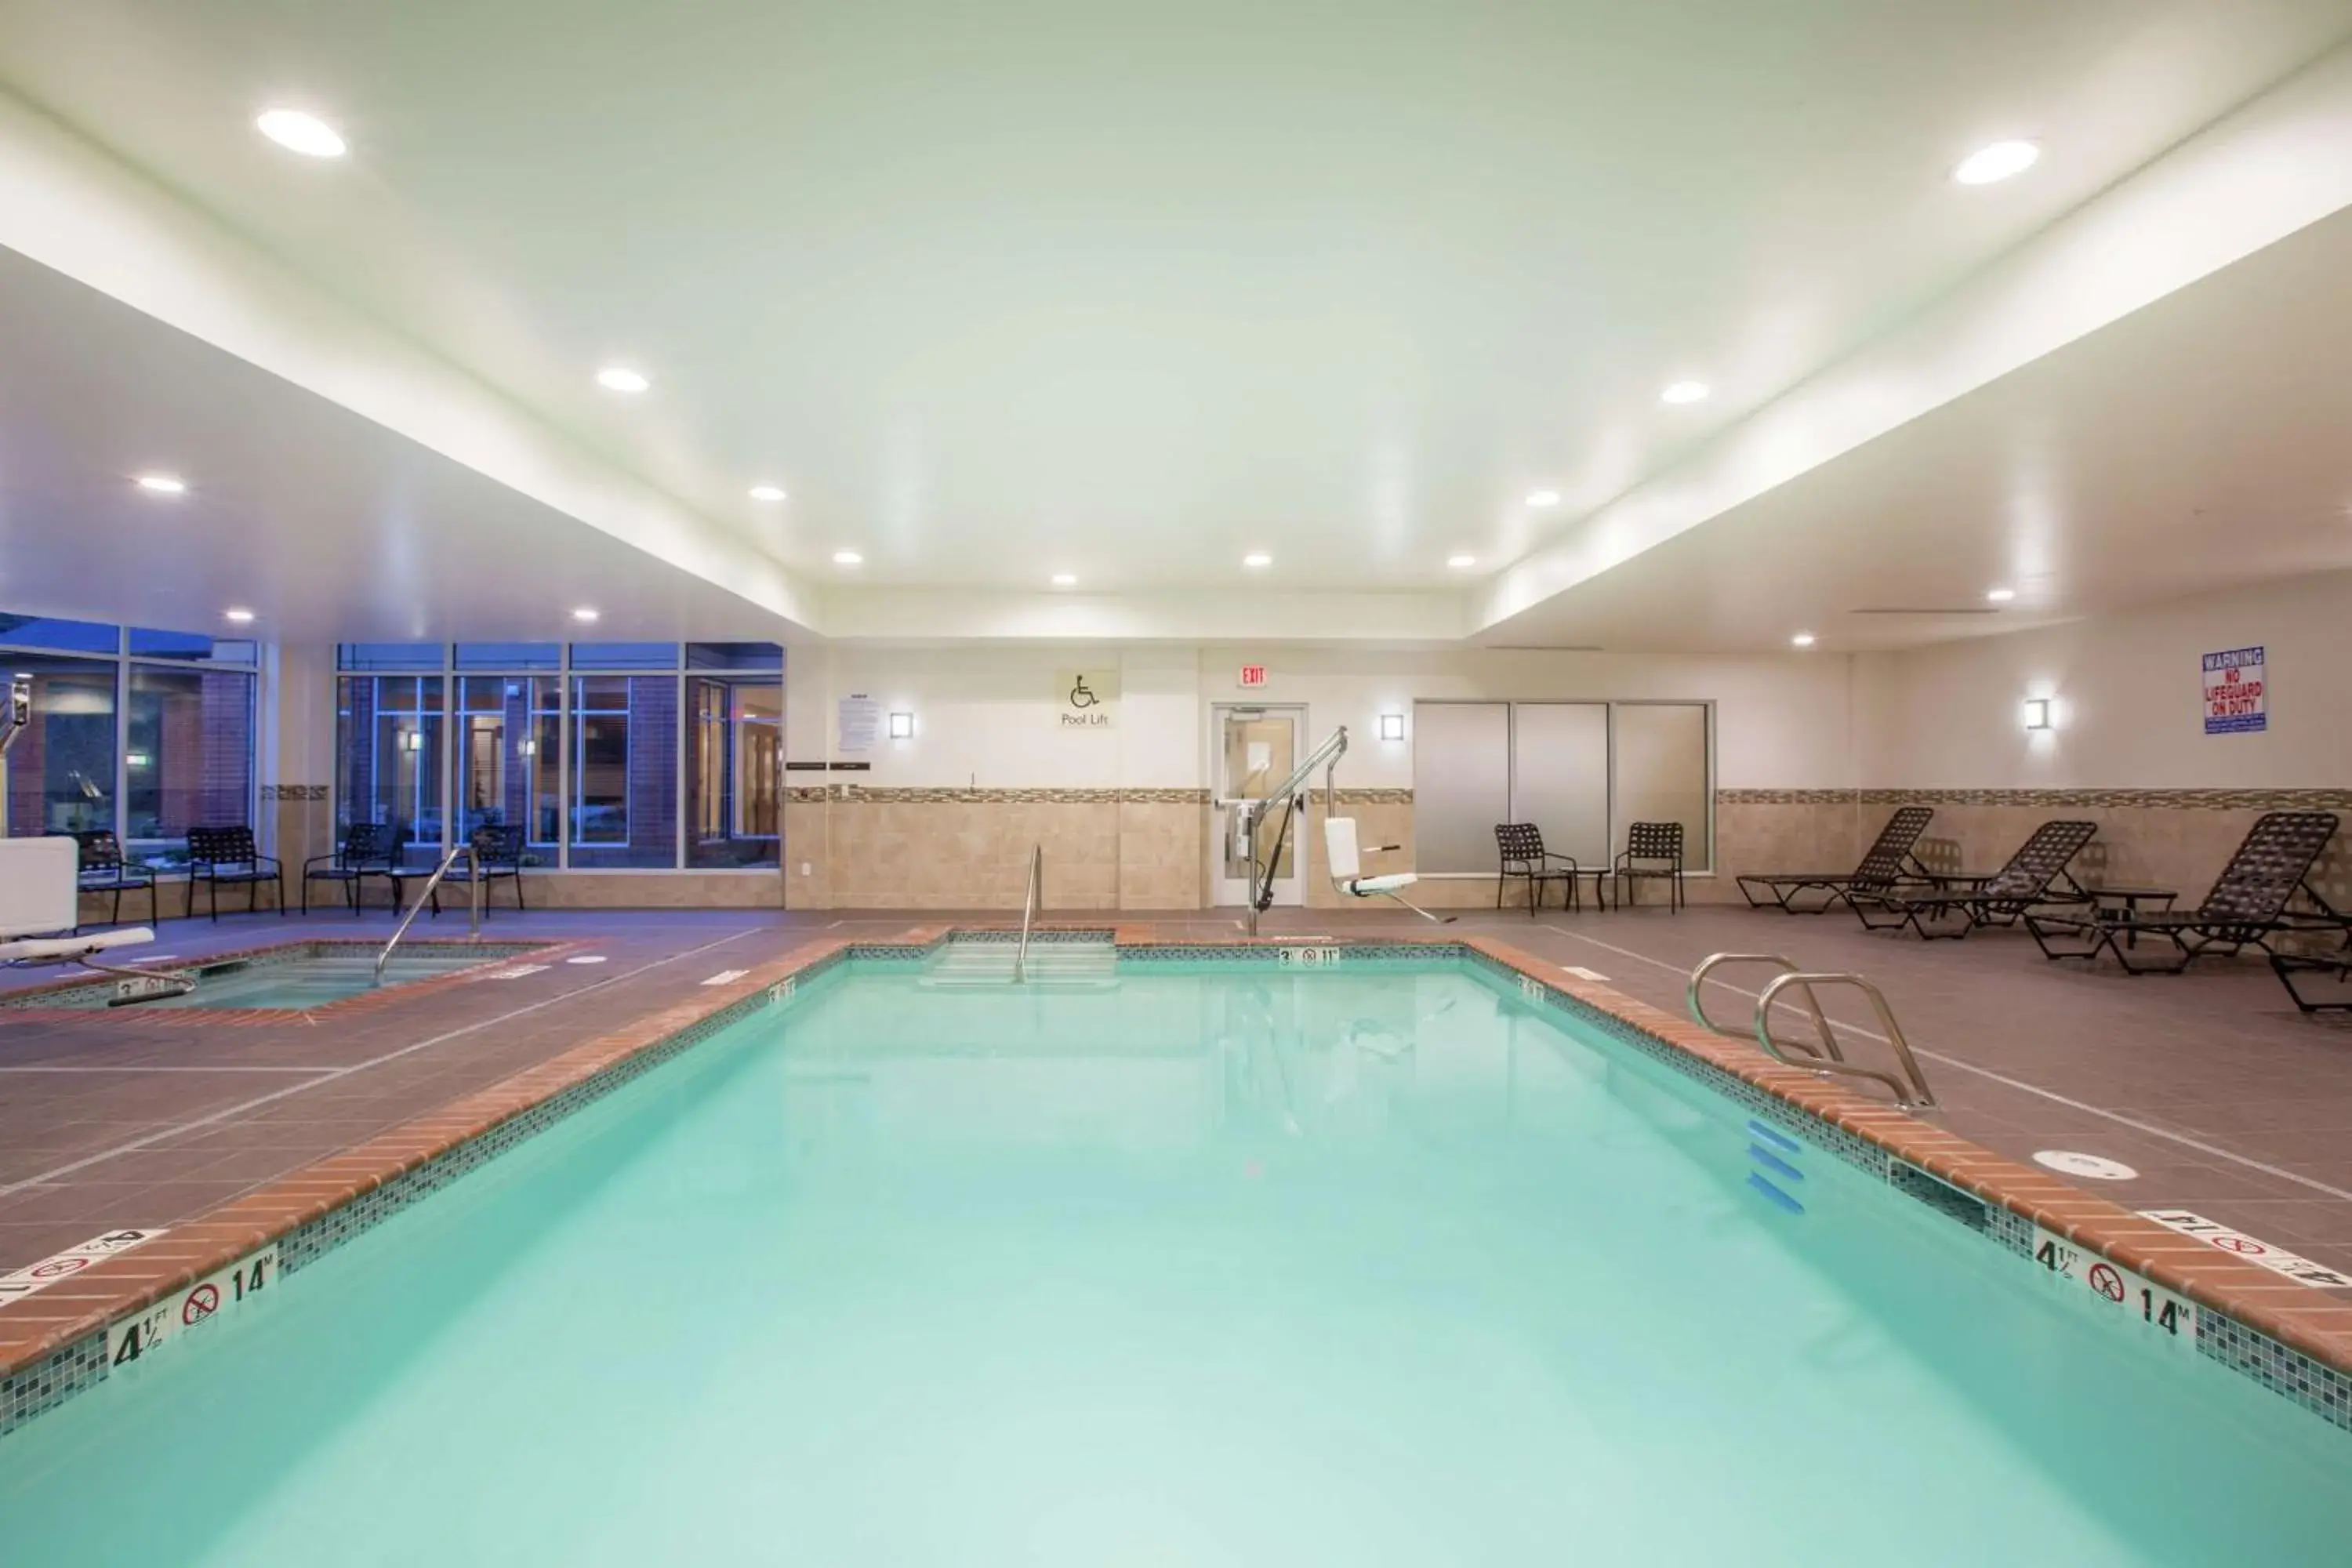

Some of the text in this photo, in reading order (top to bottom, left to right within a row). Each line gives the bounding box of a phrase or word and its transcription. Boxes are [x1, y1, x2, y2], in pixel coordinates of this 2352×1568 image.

[2205, 648, 2263, 670] WARNING
[1243, 668, 1264, 684] EXIT
[2225, 668, 2240, 684] NO
[2206, 681, 2262, 702] LIFEGUARD
[2212, 699, 2256, 716] ON DUTY
[1062, 713, 1109, 725] Pool Lift
